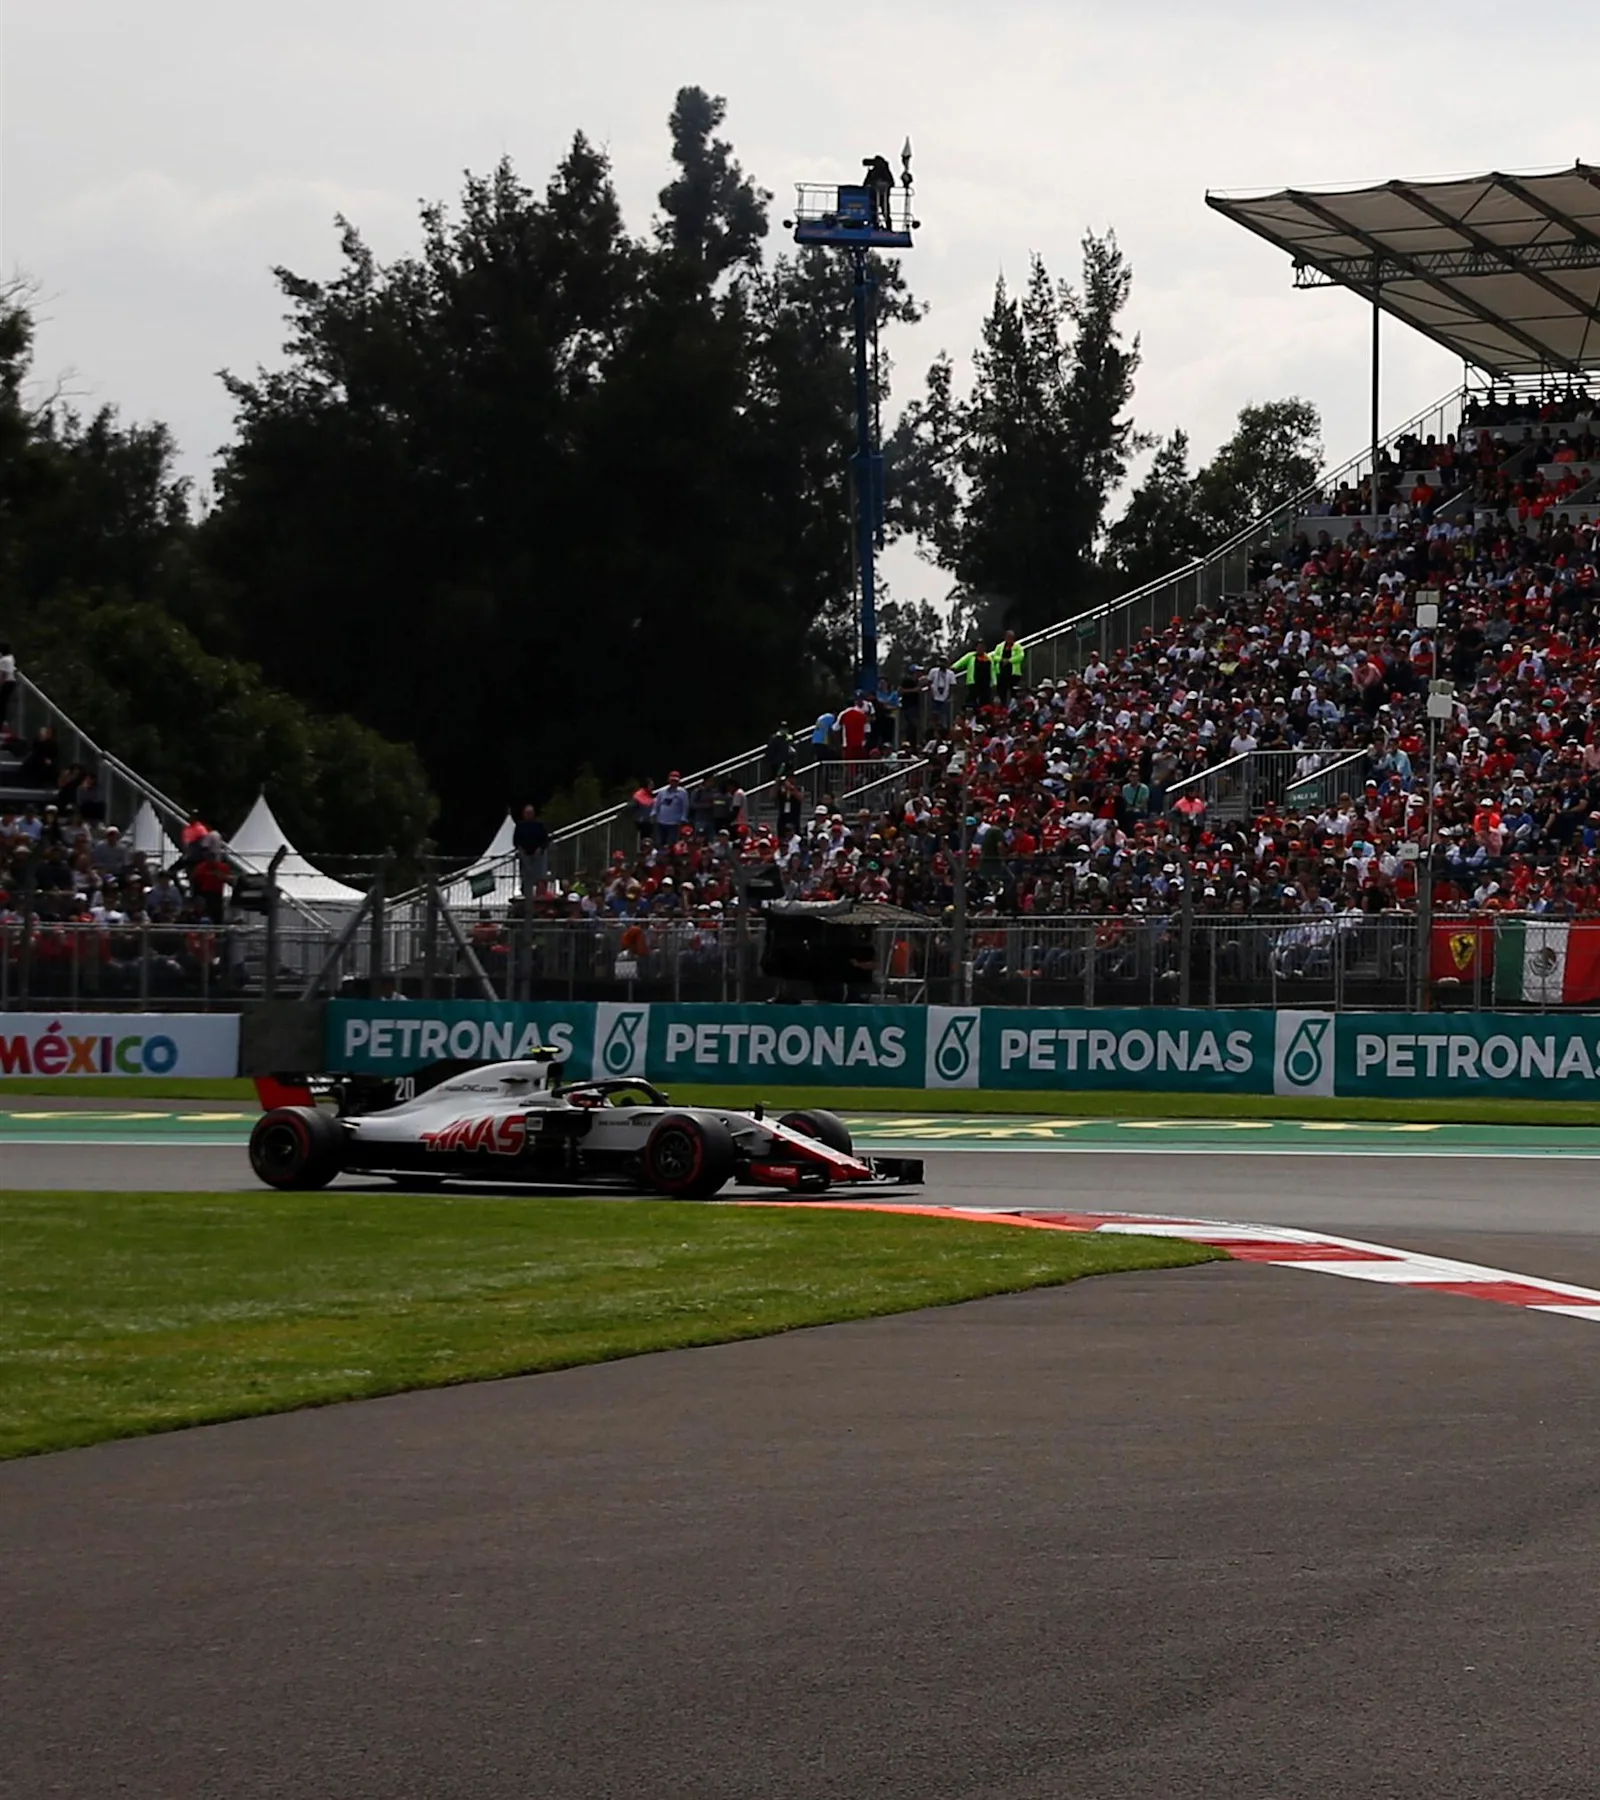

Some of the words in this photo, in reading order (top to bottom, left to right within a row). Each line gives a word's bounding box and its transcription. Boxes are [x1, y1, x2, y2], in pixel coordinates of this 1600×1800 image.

[348, 1019, 573, 1063] PETRONAS
[667, 1024, 905, 1067] PETRONAS
[1002, 1029, 1252, 1072] PETRONAS
[394, 1077, 415, 1101] 20
[420, 1114, 527, 1156] HAAS
